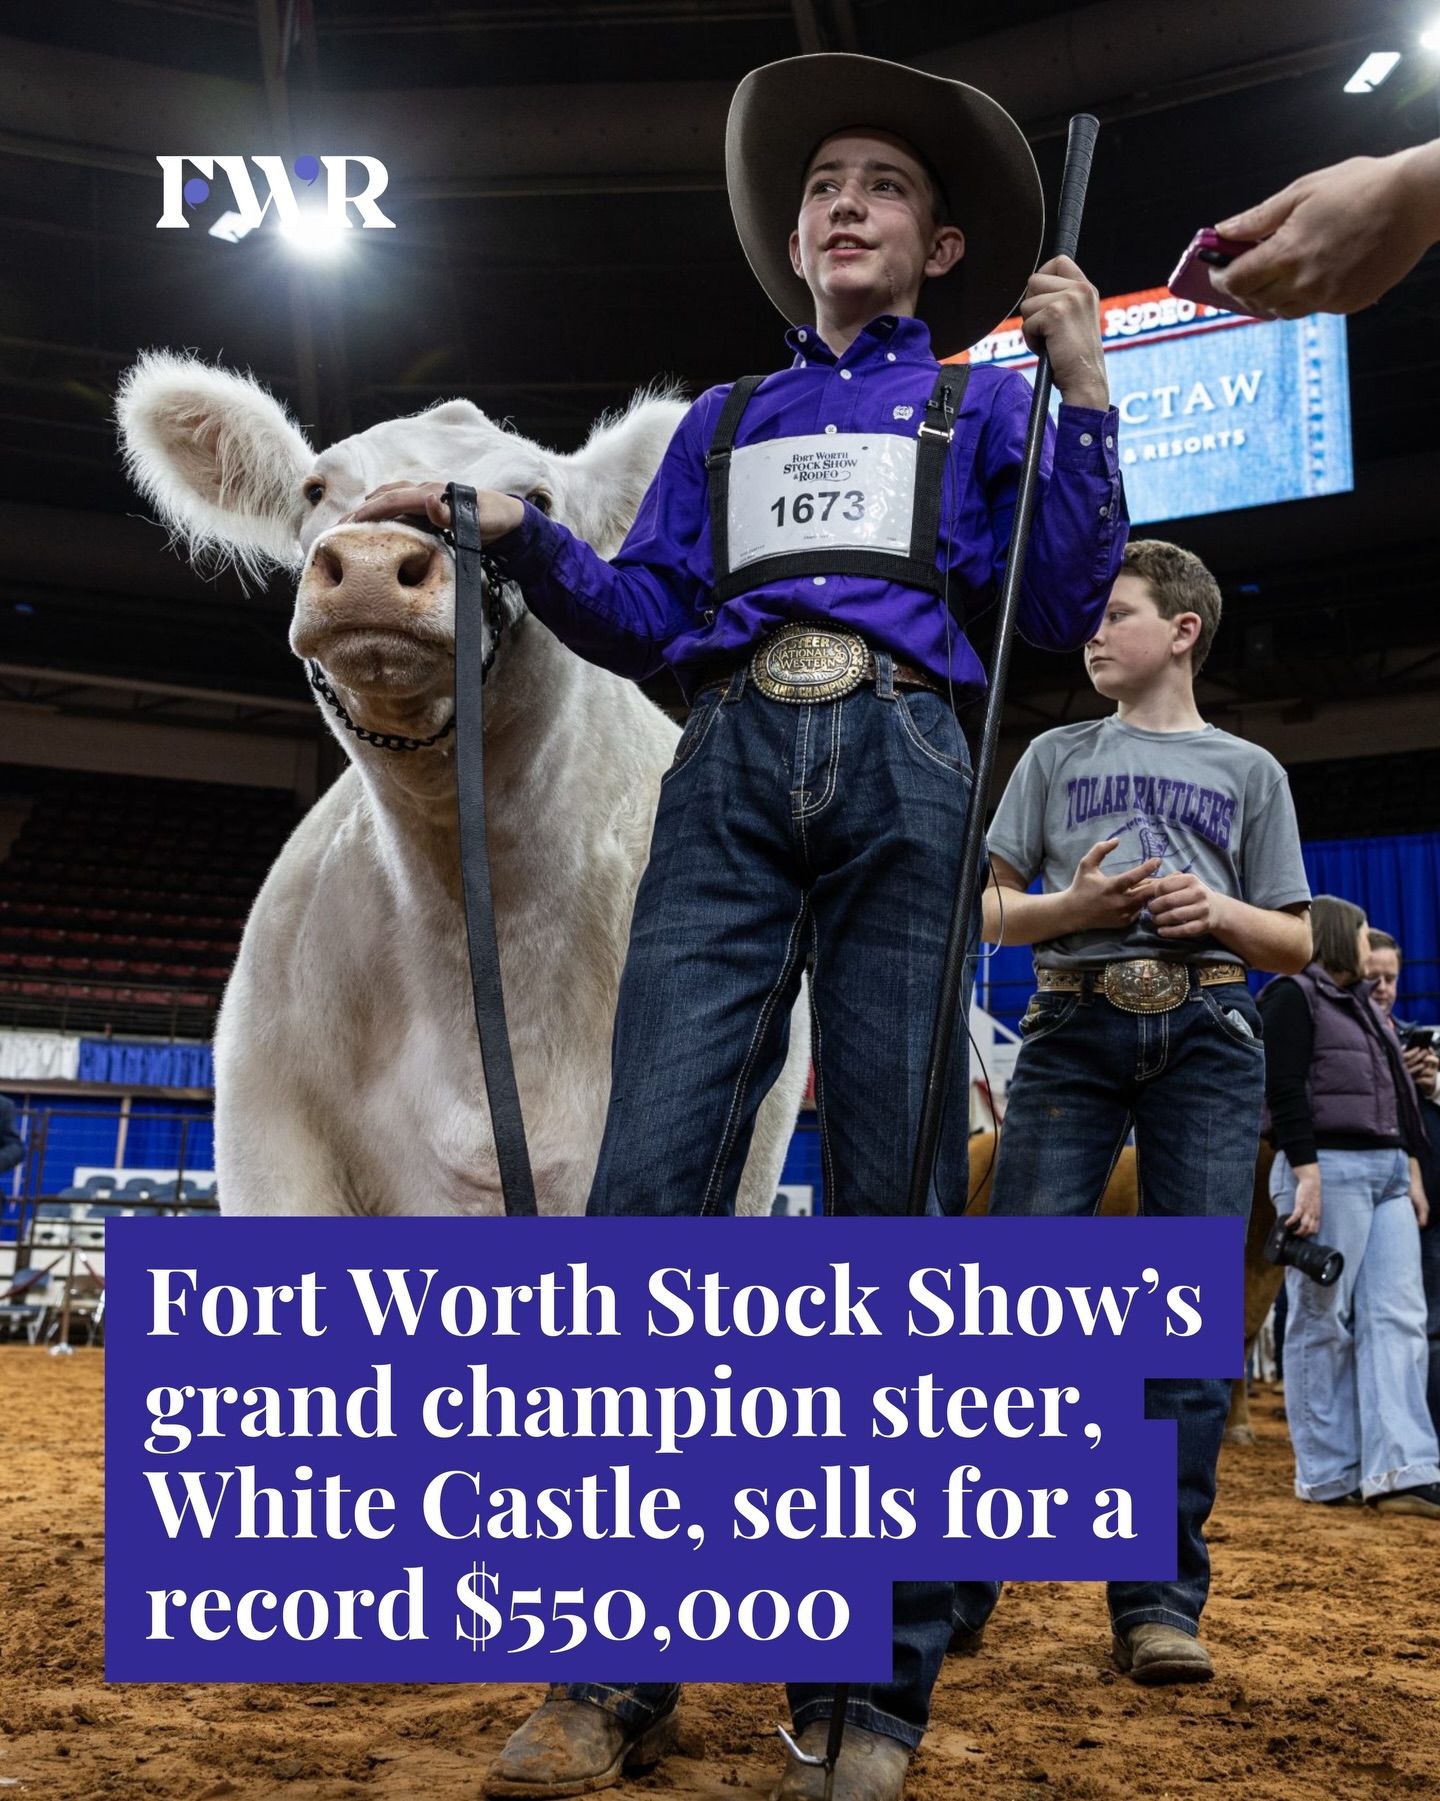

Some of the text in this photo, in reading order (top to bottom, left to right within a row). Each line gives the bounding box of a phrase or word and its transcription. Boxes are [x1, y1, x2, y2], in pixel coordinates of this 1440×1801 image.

[1105, 298, 1197, 337] RODEO
[1119, 369, 1264, 426] CTAW
[792, 451, 849, 463] FORT WORTH
[1143, 429, 1247, 461] RESORTS
[783, 459, 858, 475] STOCK SHOW
[771, 490, 866, 528] 1673
[772, 648, 829, 662] NATIONAL
[779, 657, 836, 670] WESTERN
[761, 674, 854, 698] GRAND CHAMPION
[1067, 775, 1237, 850] TOLAR RATTLERS
